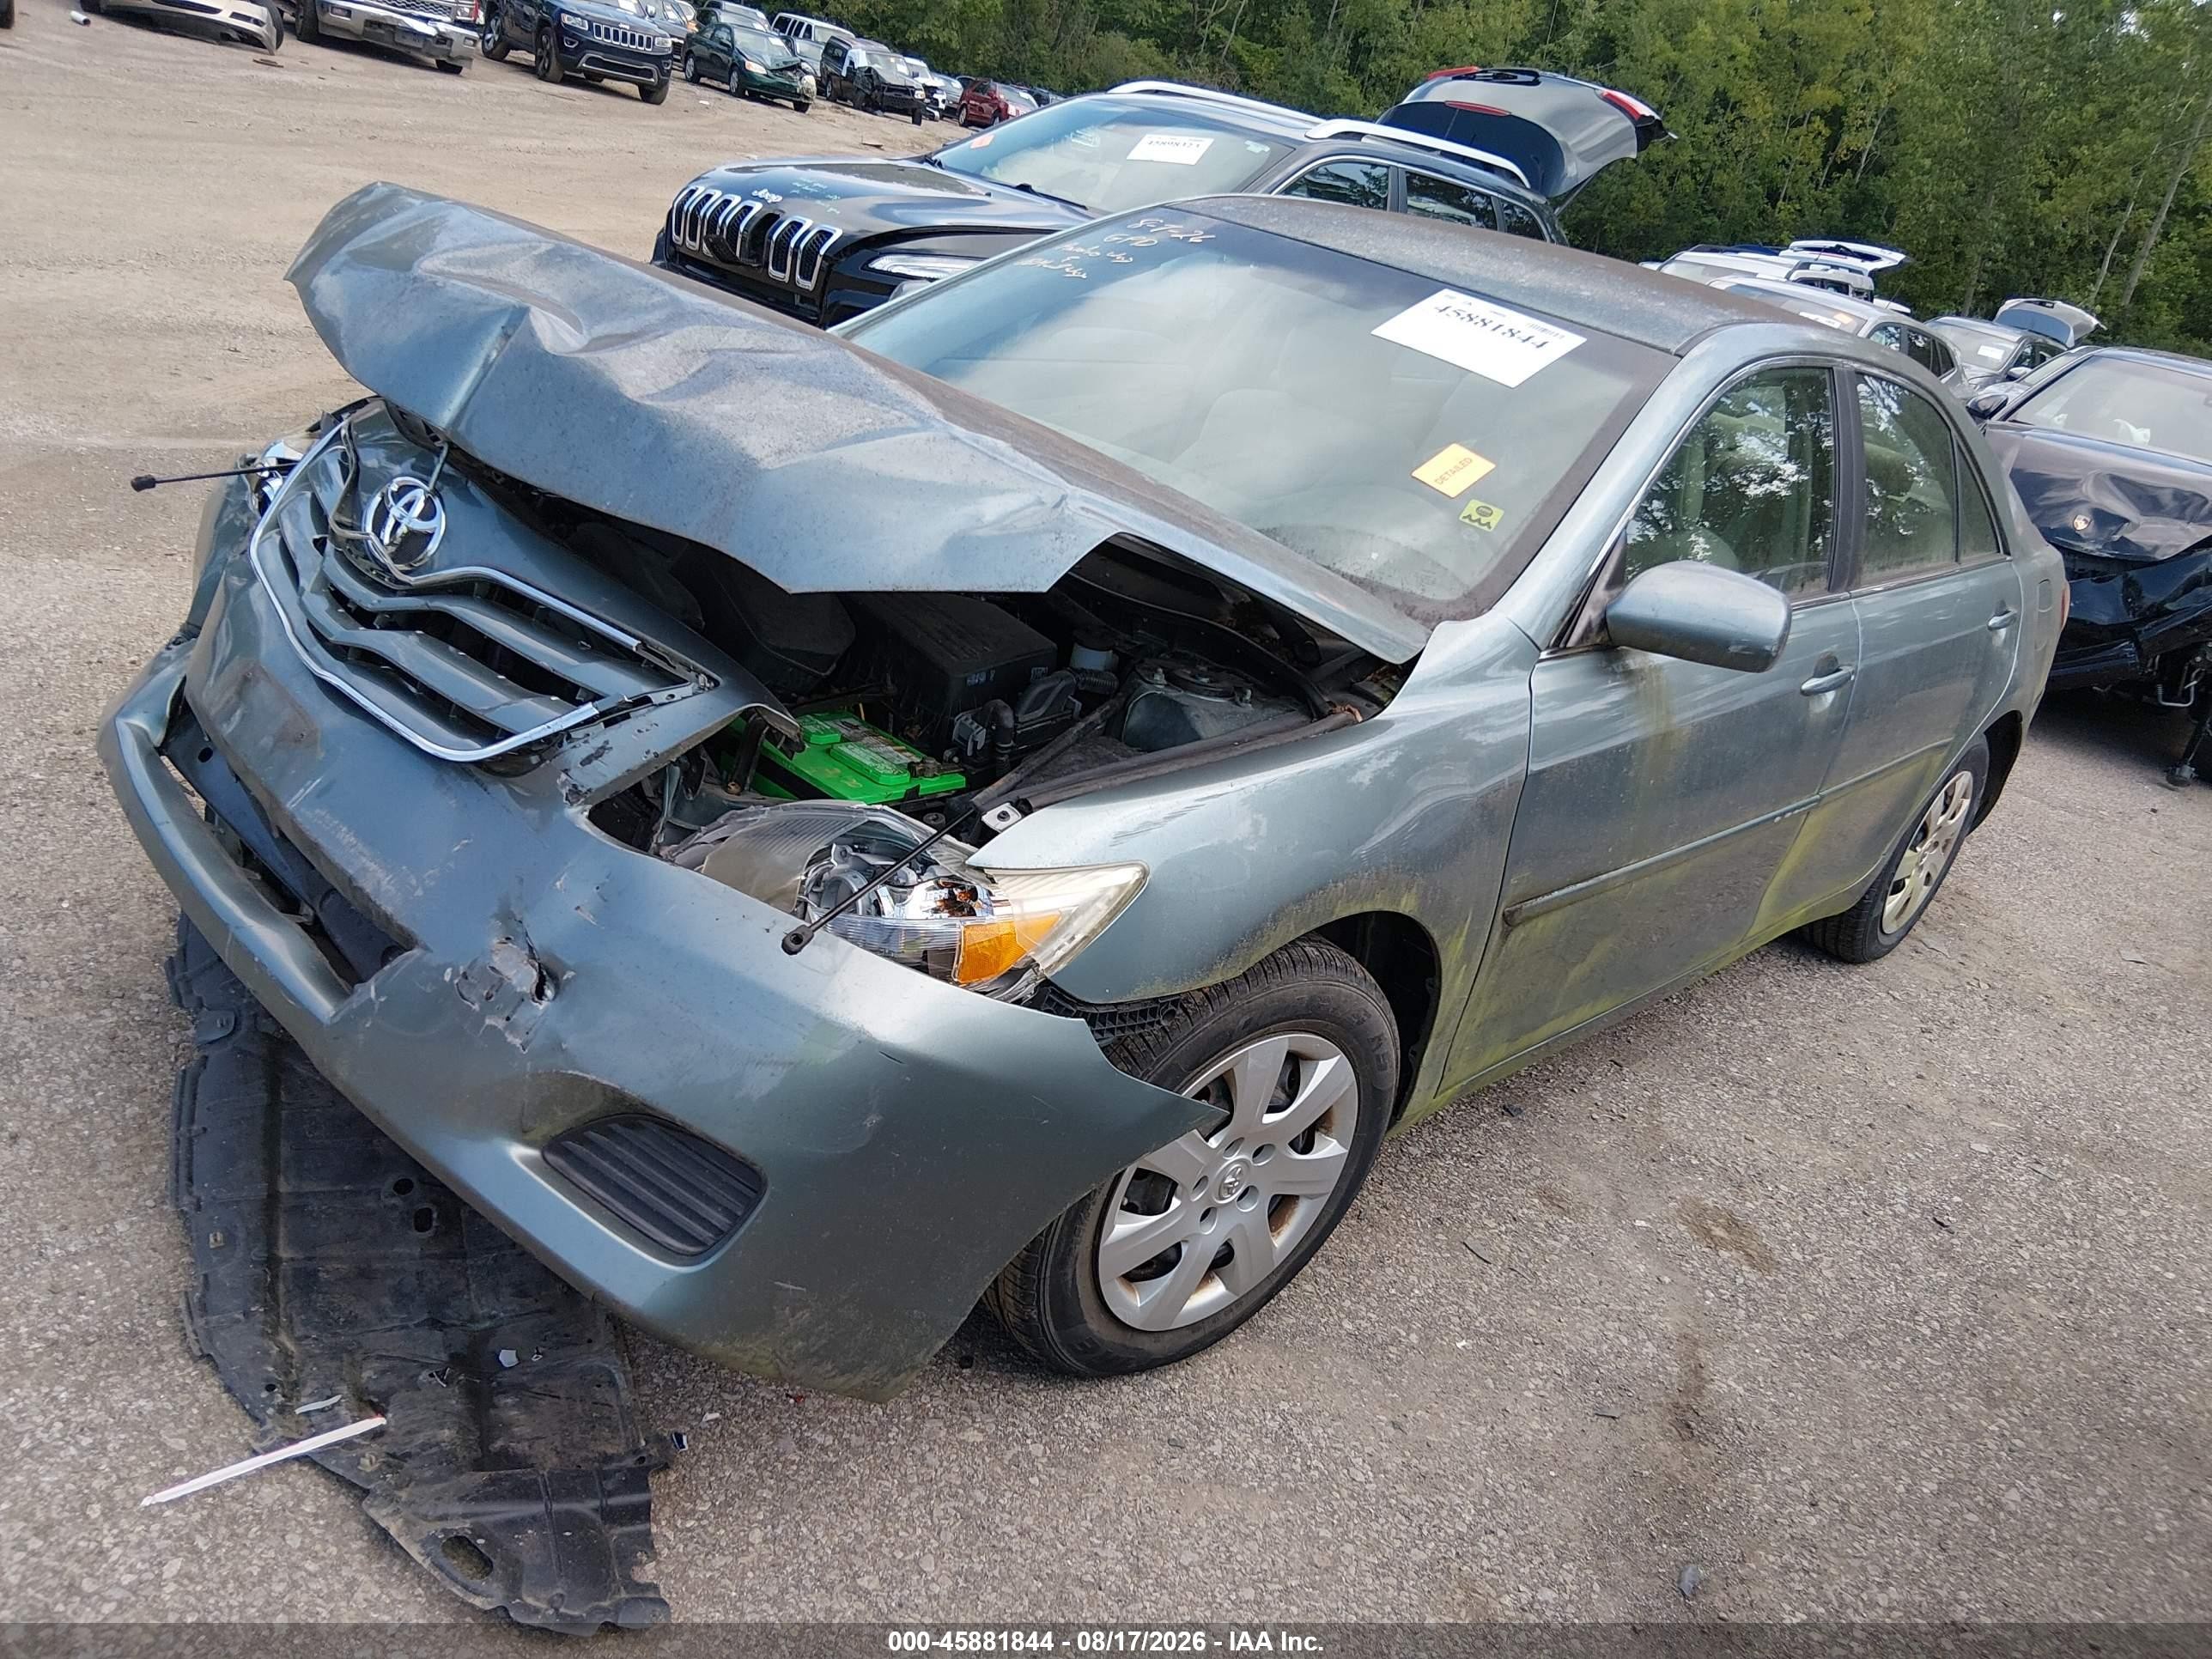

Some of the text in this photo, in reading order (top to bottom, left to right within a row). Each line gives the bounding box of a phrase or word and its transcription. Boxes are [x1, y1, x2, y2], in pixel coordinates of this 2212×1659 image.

[751, 188, 783, 204] Jeep
[1434, 305, 1549, 349] 45881844
[1434, 457, 1473, 485] DETAILED
